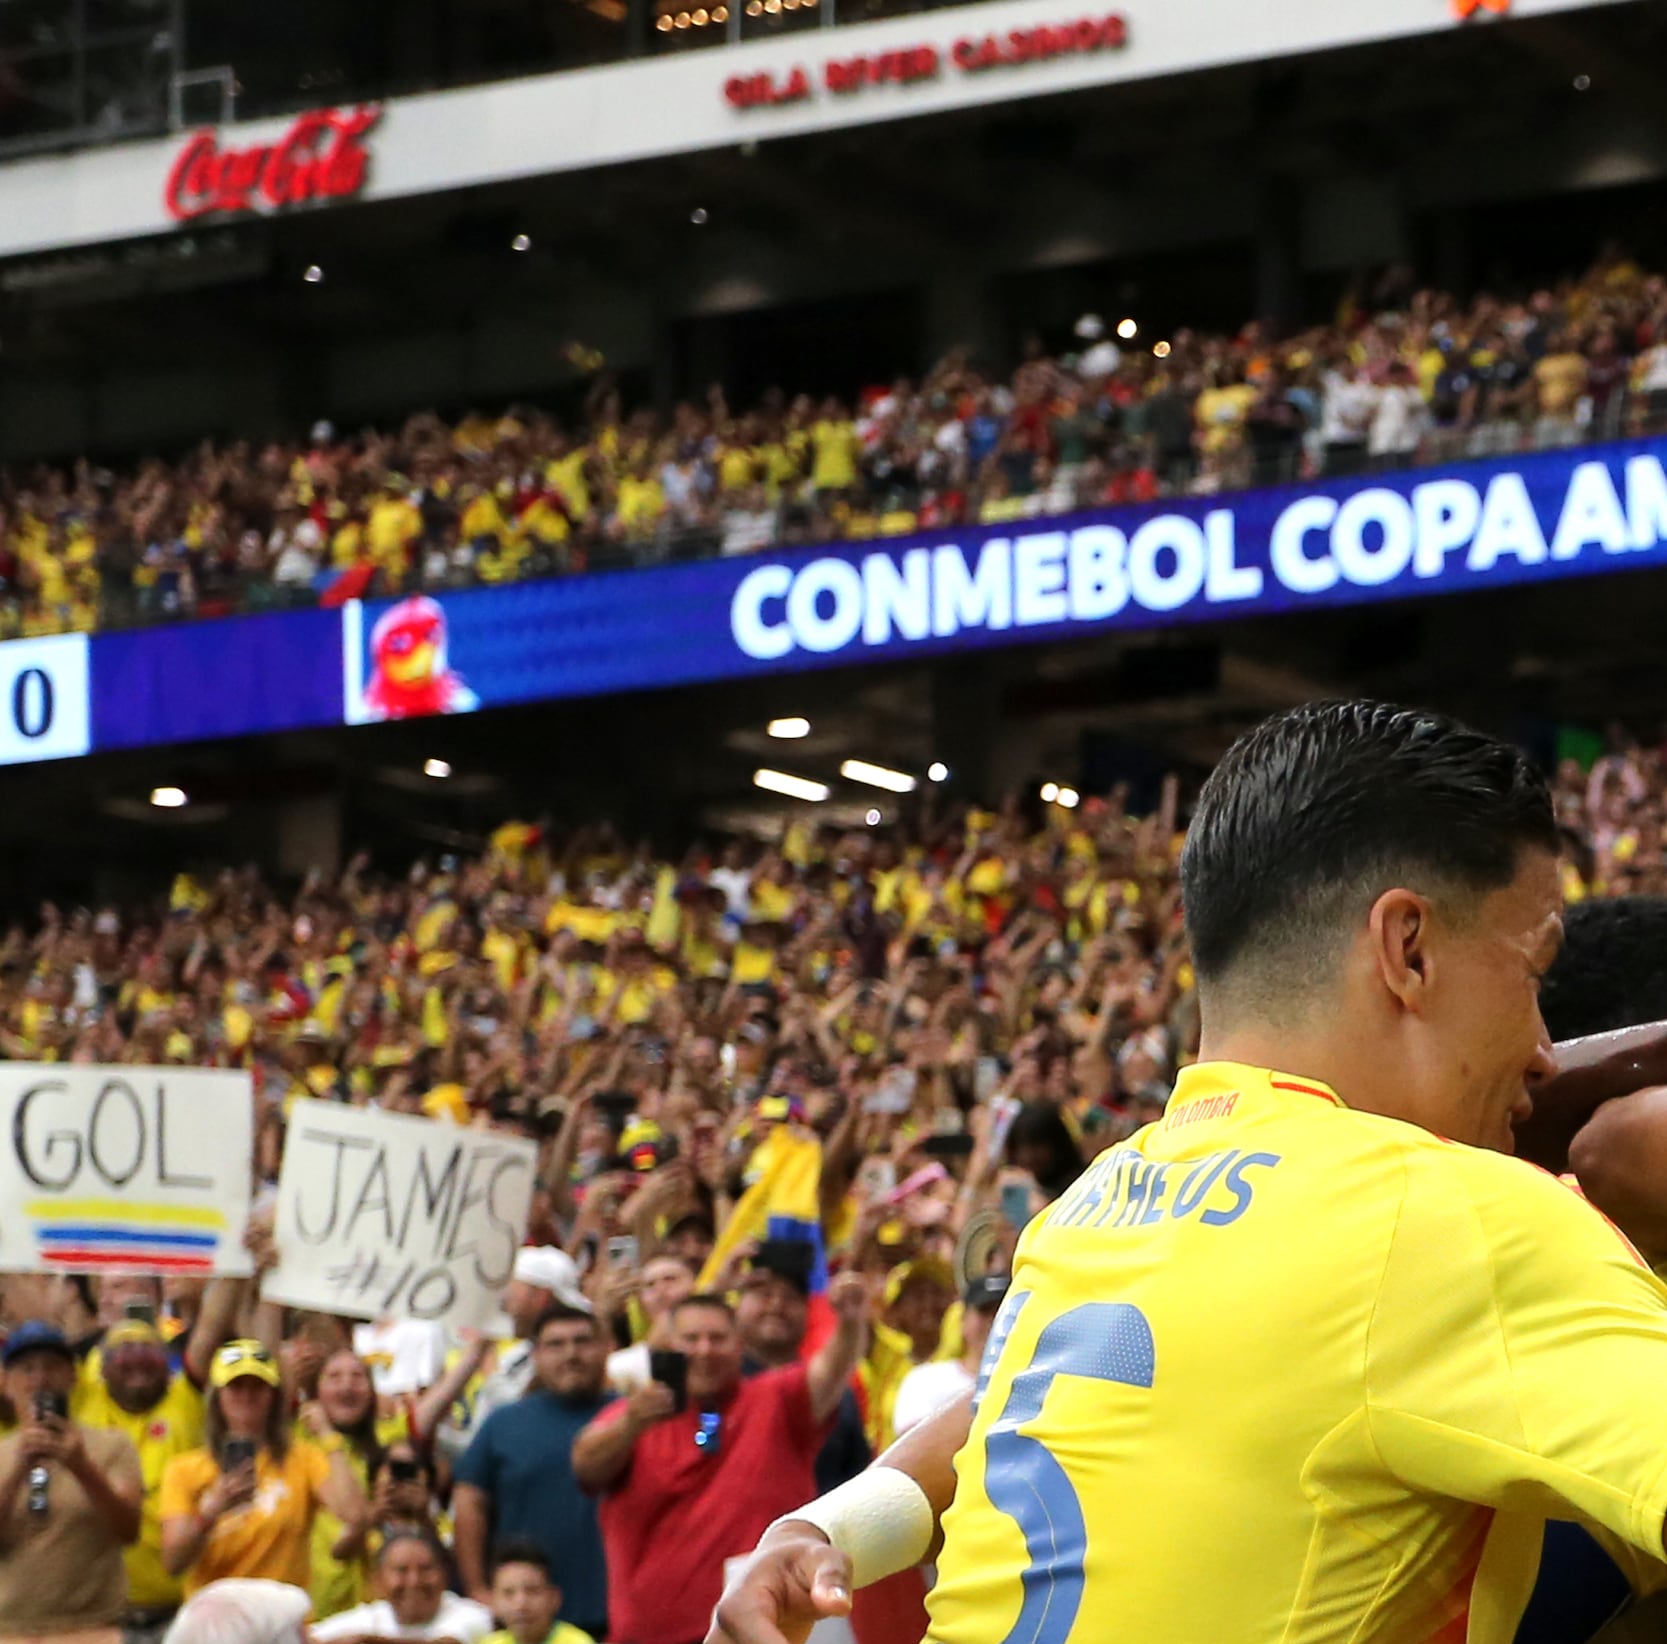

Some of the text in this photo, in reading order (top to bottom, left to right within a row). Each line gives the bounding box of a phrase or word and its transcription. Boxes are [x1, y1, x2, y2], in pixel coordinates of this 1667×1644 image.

[731, 509, 1263, 660] CONMEBOL
[1270, 471, 1548, 593] COPA
[13, 667, 53, 738] 0
[13, 1080, 214, 1192] GOL
[1165, 1092, 1241, 1132] COLOMBIA
[297, 1128, 529, 1289] JAMES
